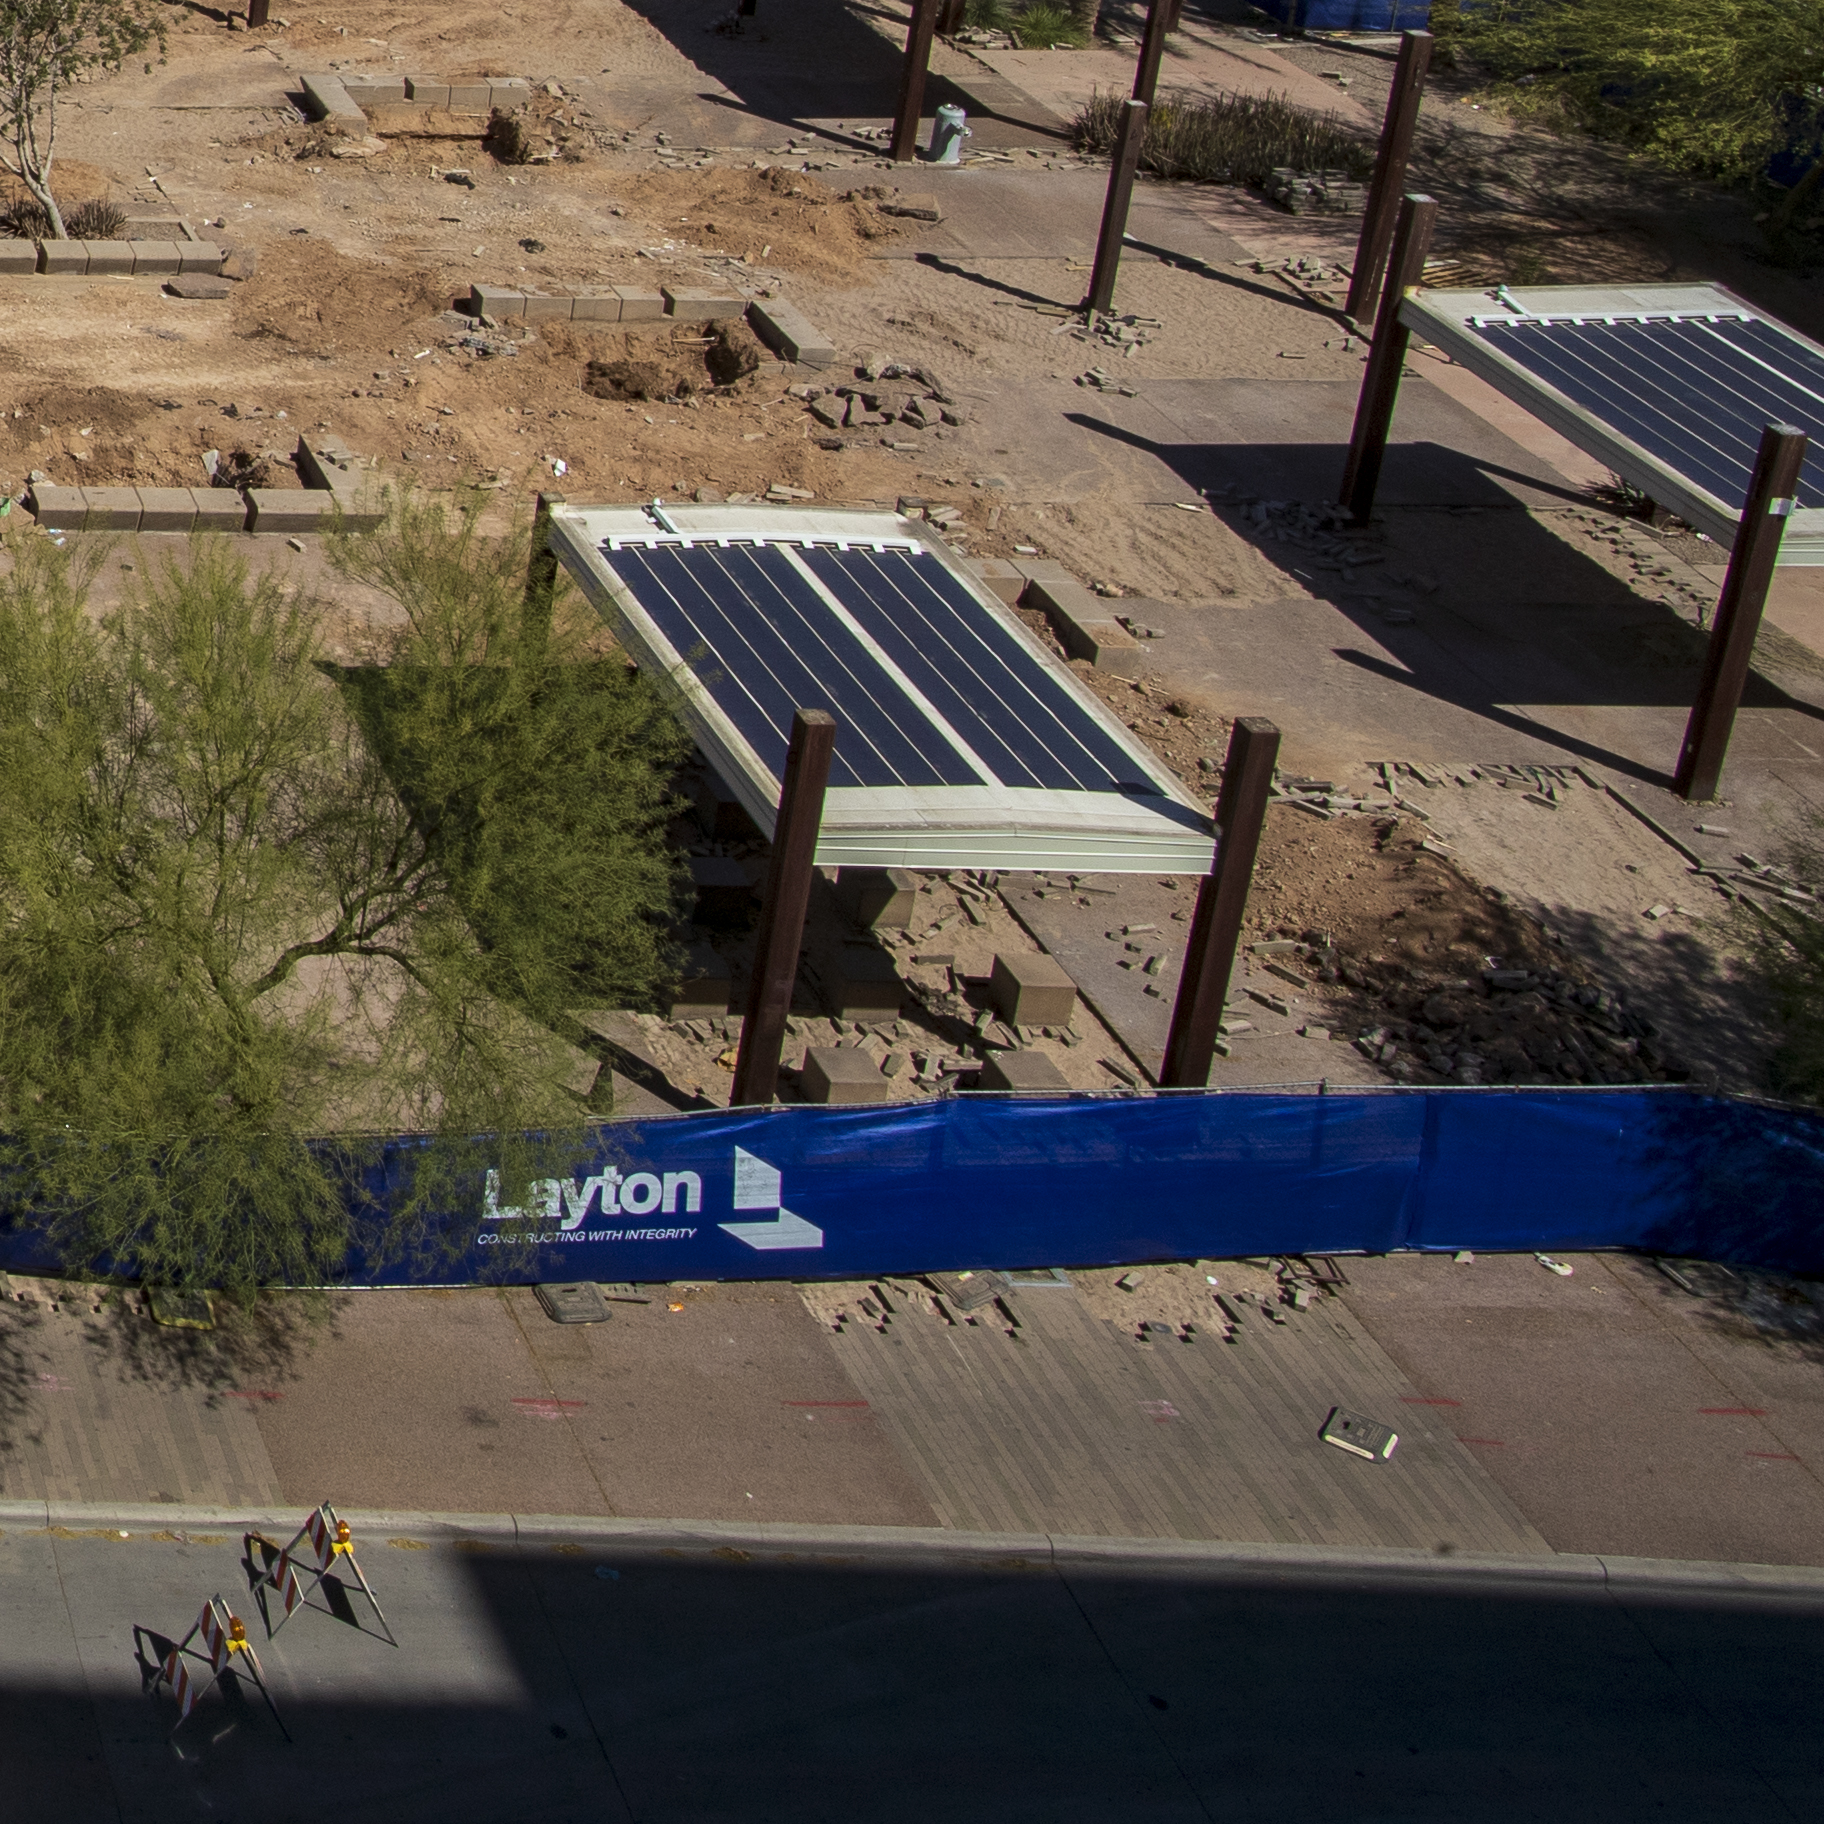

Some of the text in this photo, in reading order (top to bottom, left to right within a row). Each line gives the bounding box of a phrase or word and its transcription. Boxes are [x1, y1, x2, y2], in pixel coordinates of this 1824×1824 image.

[481, 1164, 702, 1231] Layton
[587, 1229, 623, 1242] WITH
[625, 1227, 697, 1240] INTEGRITY
